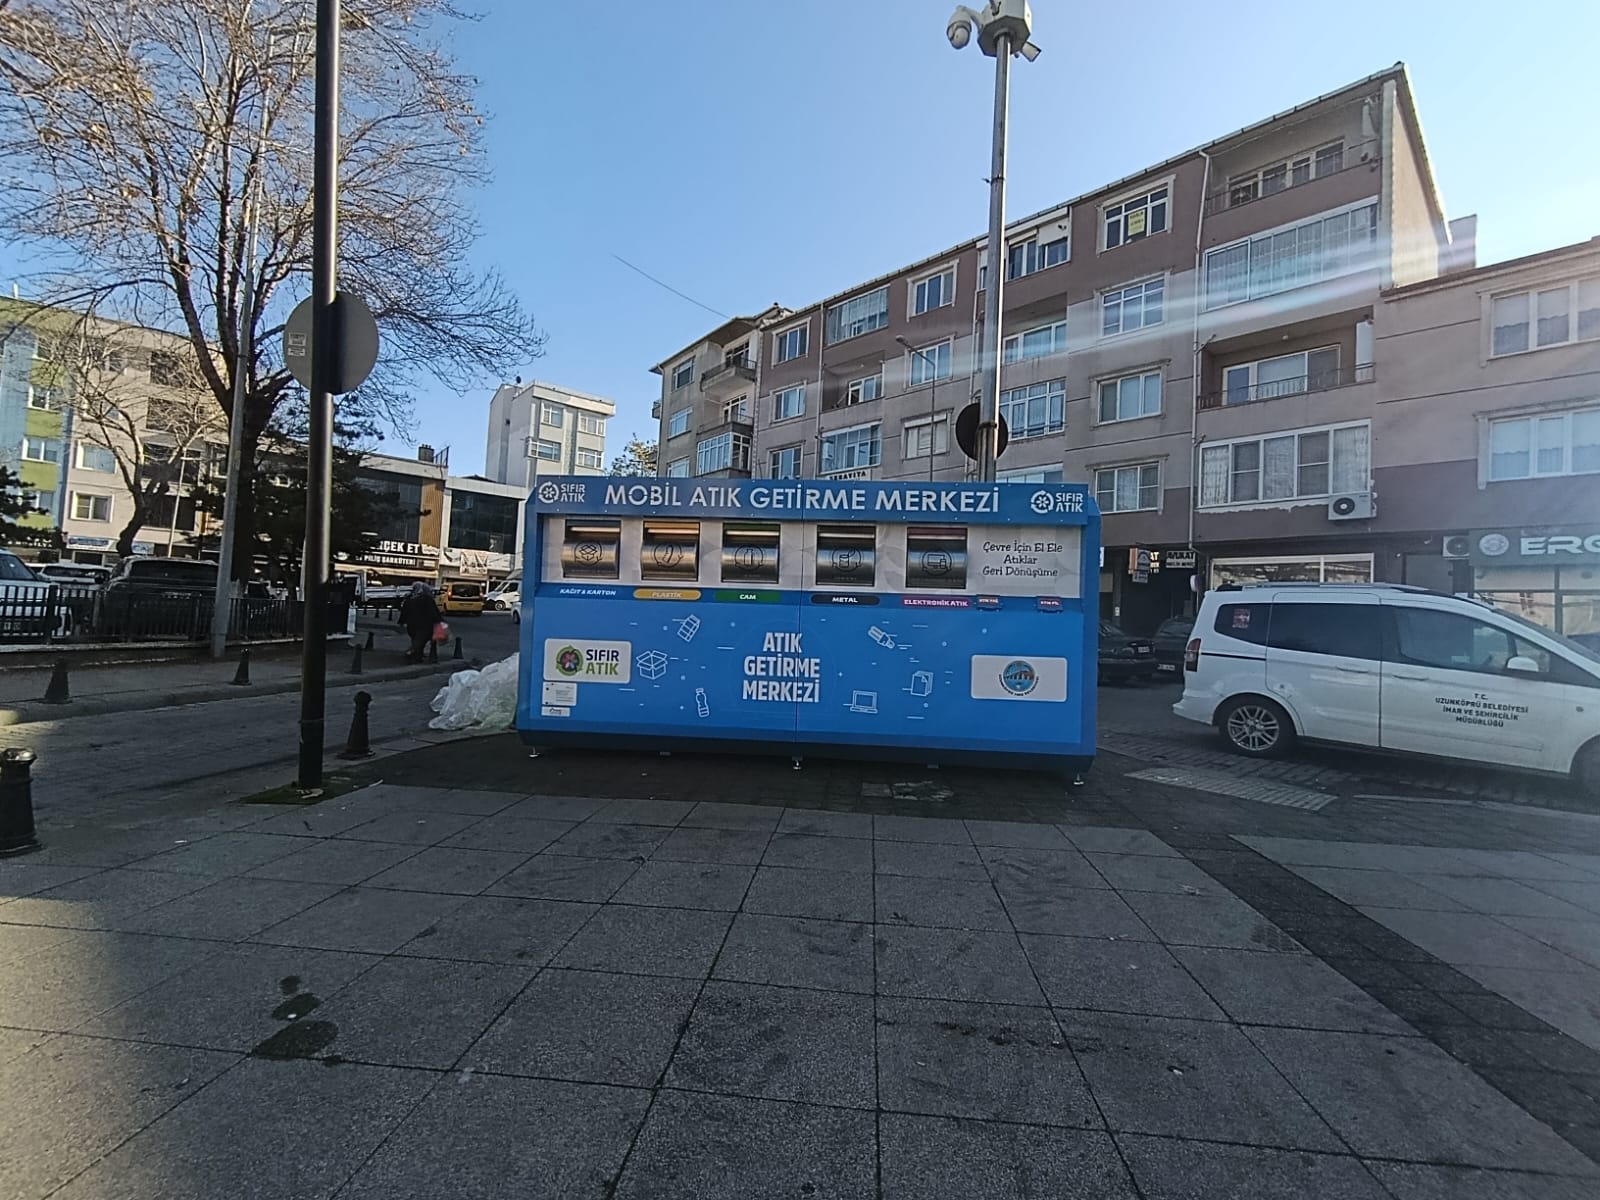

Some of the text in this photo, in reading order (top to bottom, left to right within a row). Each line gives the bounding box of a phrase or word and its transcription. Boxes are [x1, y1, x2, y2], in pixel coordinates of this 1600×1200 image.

[560, 483, 586, 493] SIFIR
[560, 493, 585, 503] ATIK
[604, 482, 999, 513] MOBİL ATIK GETİRME MERKEZİ
[1055, 492, 1083, 502] SIFIR
[1055, 502, 1083, 513] ATIK
[983, 540, 1063, 553] Çevre İçin El Ele
[1003, 554, 1038, 565] Atıklar
[982, 566, 1058, 578] Geri Dönüşüme
[762, 632, 803, 653] ATIK
[585, 649, 620, 662] SIFIR
[585, 662, 619, 676] ATIK
[743, 653, 821, 678] GETİRME
[742, 679, 820, 703] MERKEZİ
